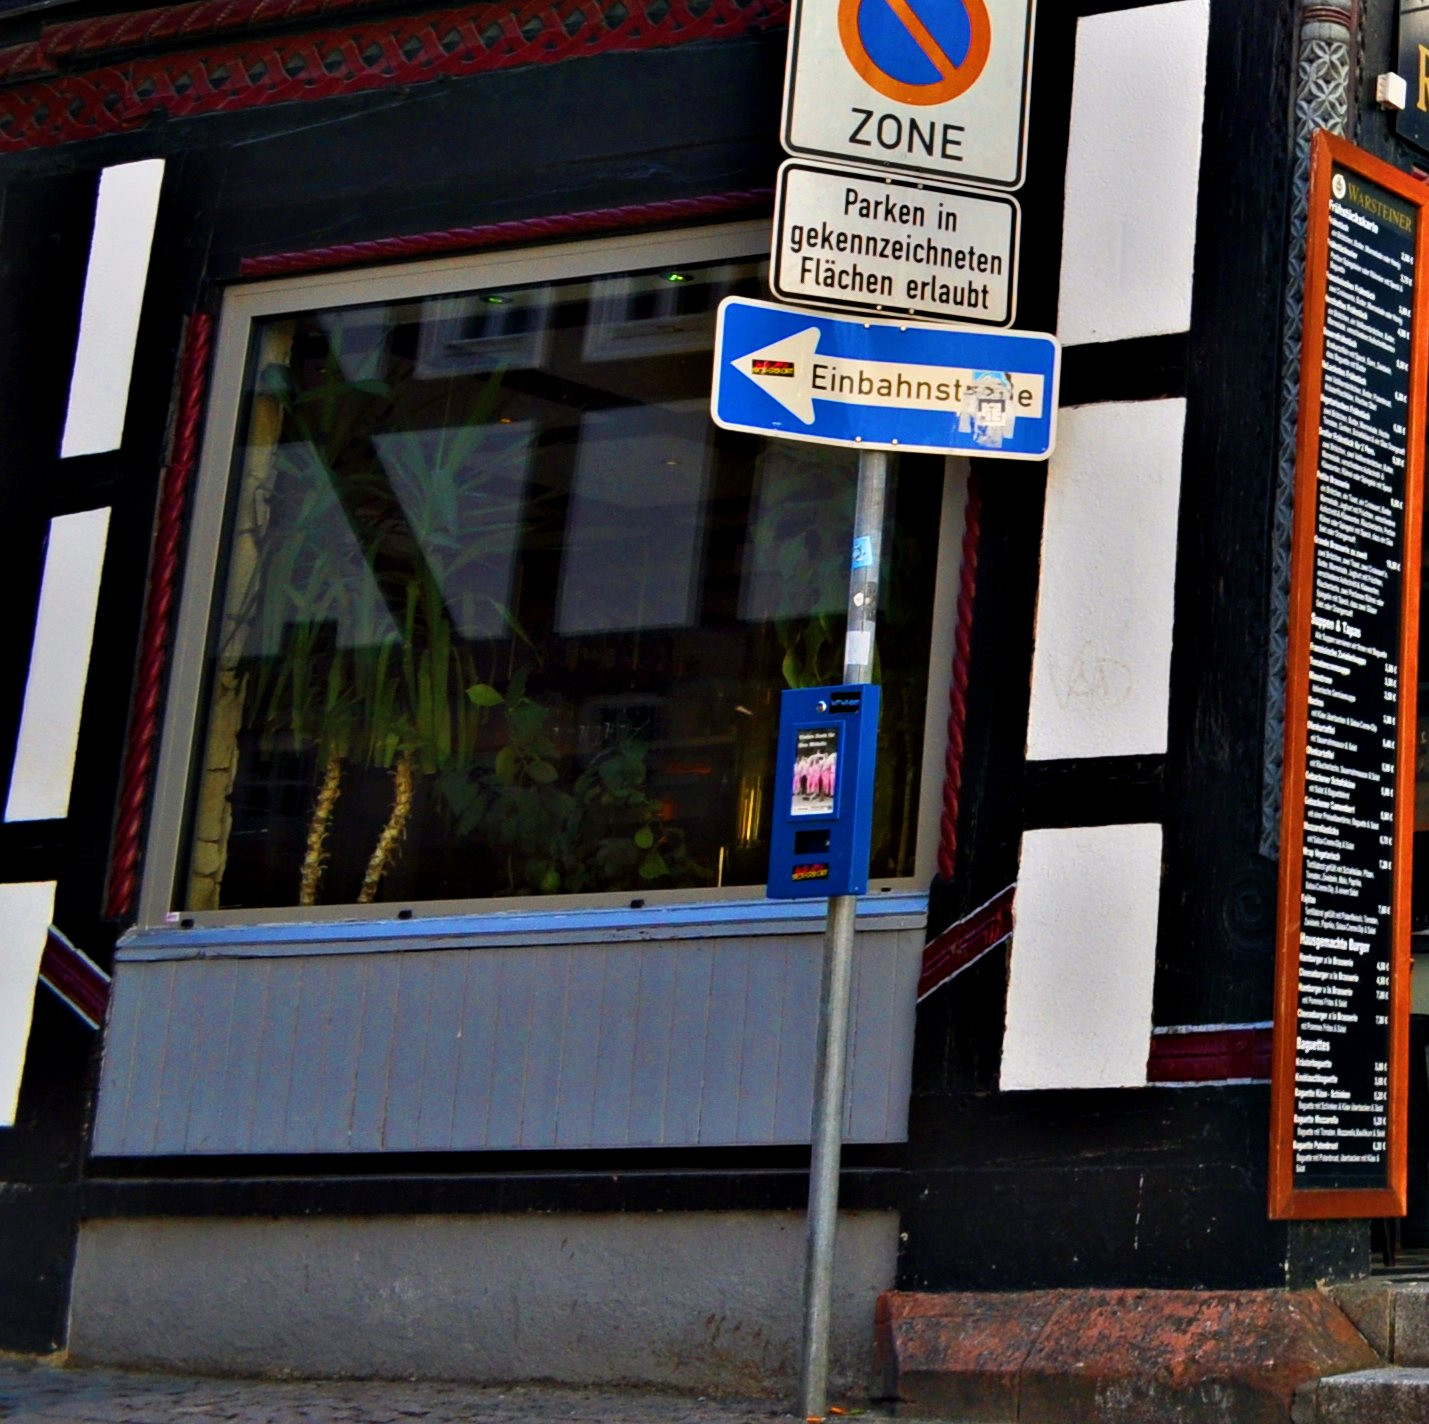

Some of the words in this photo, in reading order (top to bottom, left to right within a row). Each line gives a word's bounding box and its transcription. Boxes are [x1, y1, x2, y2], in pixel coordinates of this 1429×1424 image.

[849, 107, 966, 161] ZONE
[843, 188, 925, 228] Parken
[937, 203, 958, 232] in
[1348, 182, 1412, 232] WARSTEINER
[790, 222, 1003, 276] gekennzeichneten
[800, 256, 893, 297] Flächen
[906, 274, 990, 311] erlaubt
[812, 363, 1033, 407] Einbahnste
